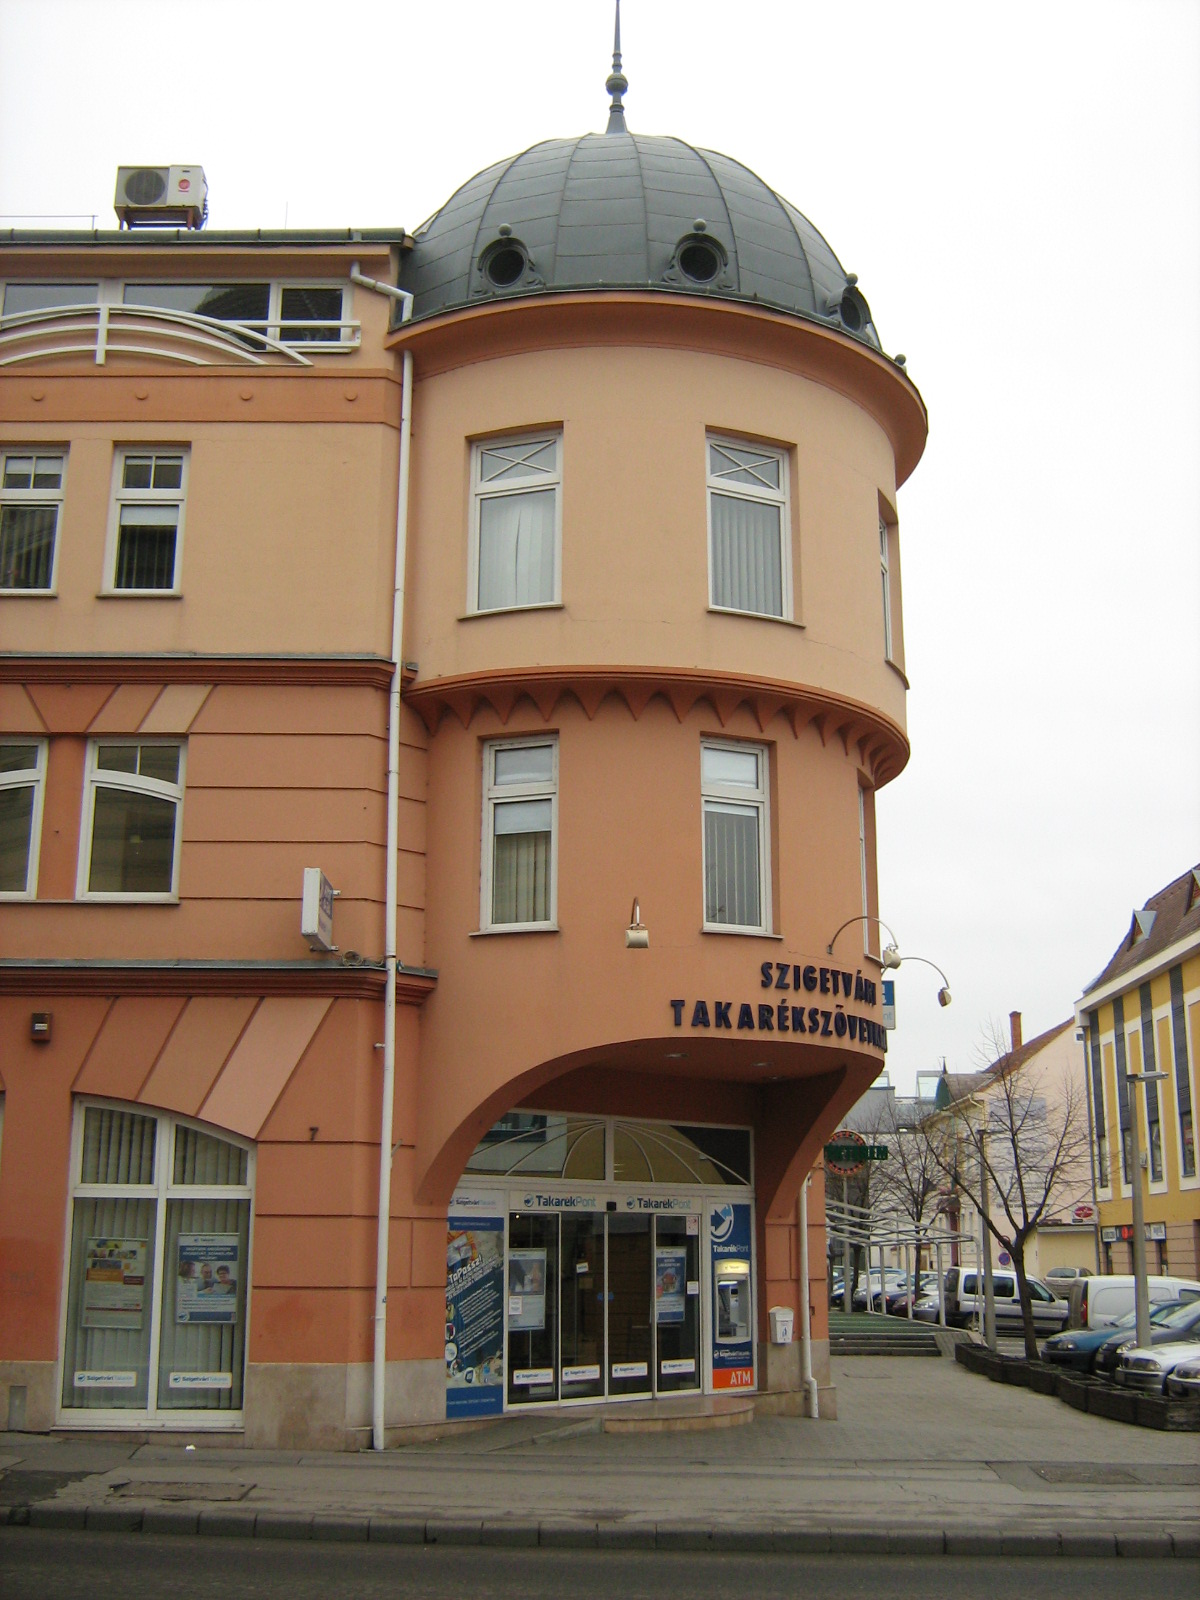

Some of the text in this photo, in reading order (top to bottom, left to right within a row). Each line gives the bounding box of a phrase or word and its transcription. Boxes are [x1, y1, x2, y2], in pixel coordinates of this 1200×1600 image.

[761, 961, 877, 1005] SZIGETVÁRI
[309, 1126, 319, 1141] 7
[730, 1370, 751, 1385] ATM
